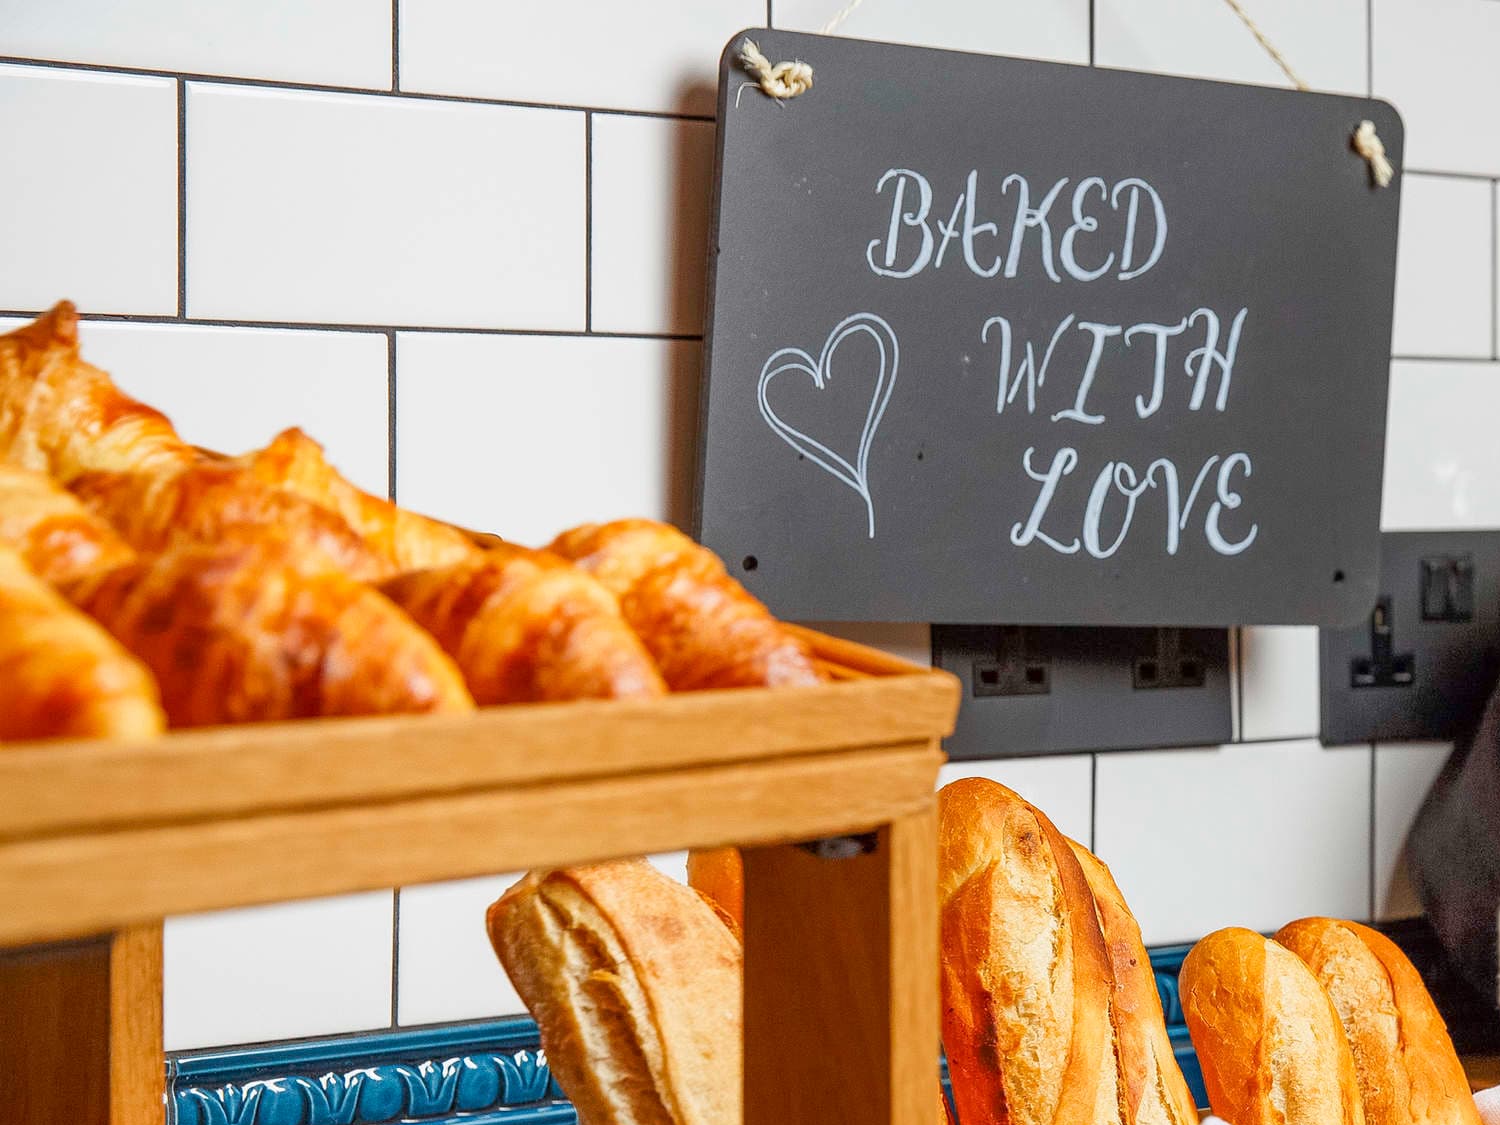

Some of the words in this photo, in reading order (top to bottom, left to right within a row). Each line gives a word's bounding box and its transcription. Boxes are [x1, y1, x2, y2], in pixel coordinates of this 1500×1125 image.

[866, 168, 1168, 283] BAKED
[982, 307, 1249, 425] WITH
[1010, 446, 1258, 559] LOVE
